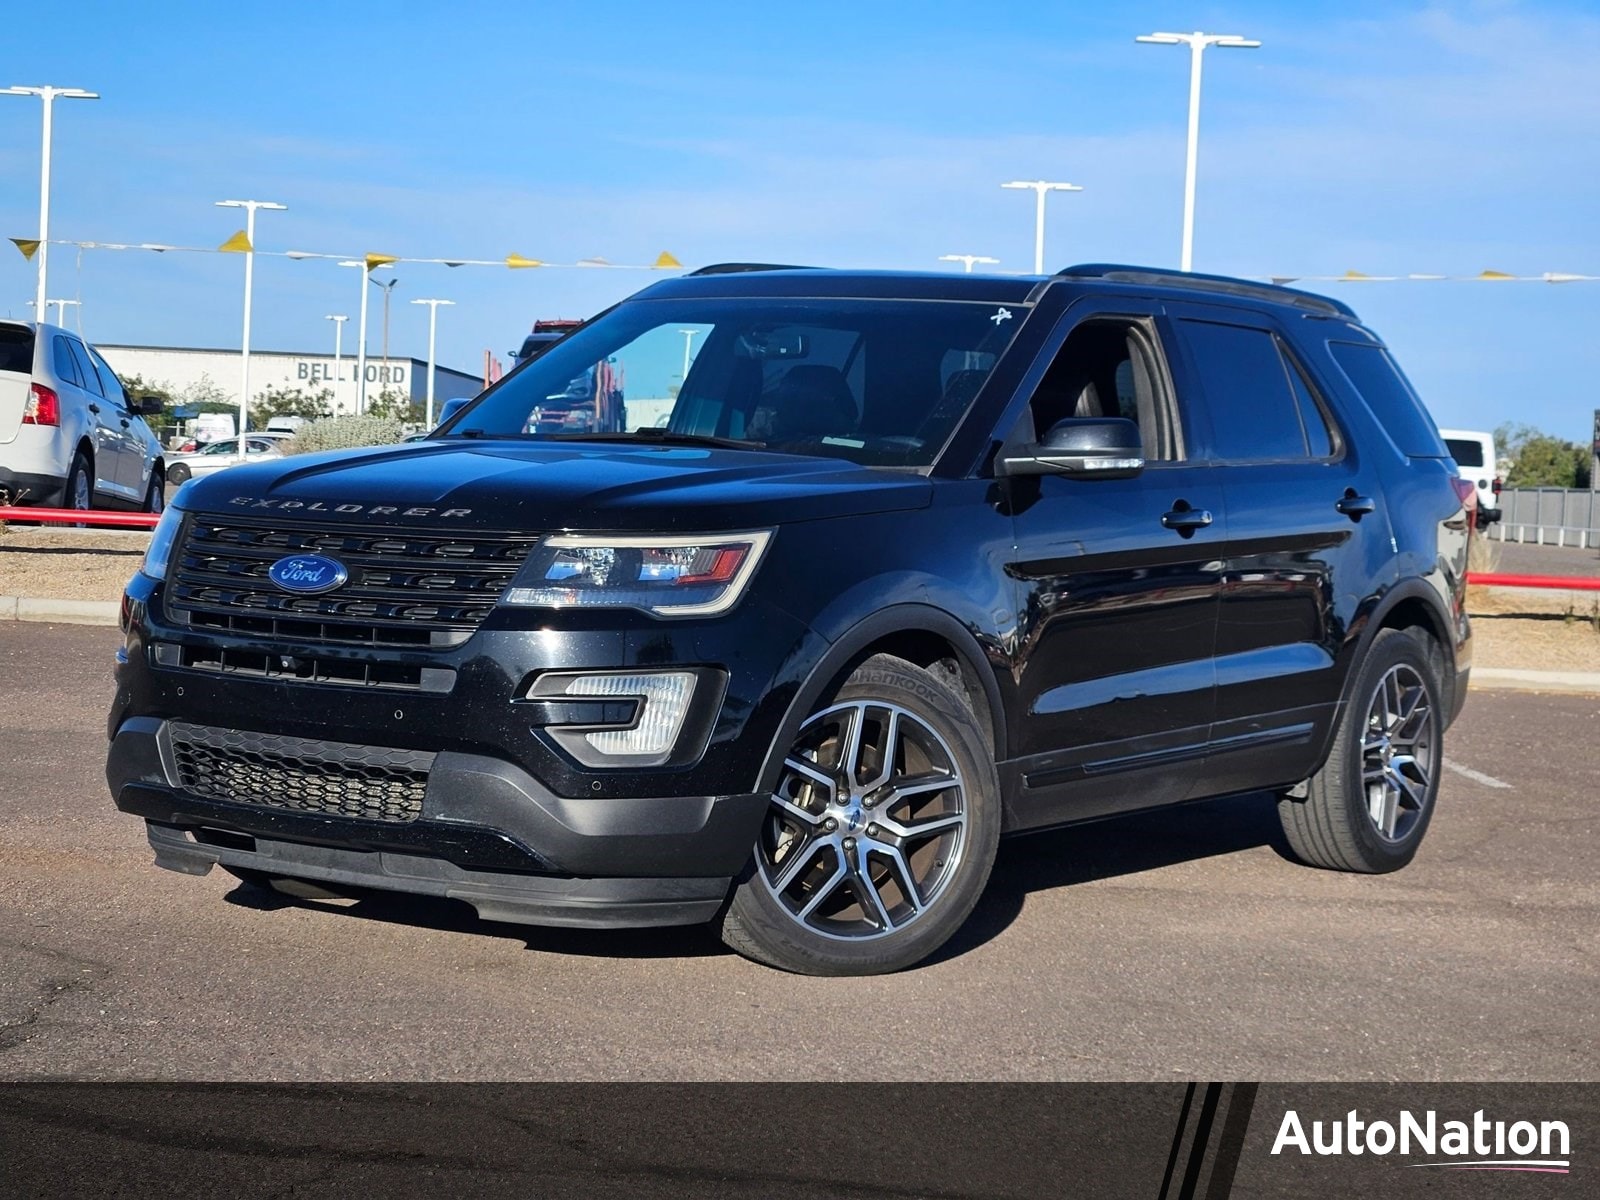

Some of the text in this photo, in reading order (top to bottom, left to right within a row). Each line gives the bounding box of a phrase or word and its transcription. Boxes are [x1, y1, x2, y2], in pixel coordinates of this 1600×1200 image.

[297, 362, 345, 381] BEL
[229, 496, 472, 517] EXPLORER
[280, 559, 322, 583] Ford
